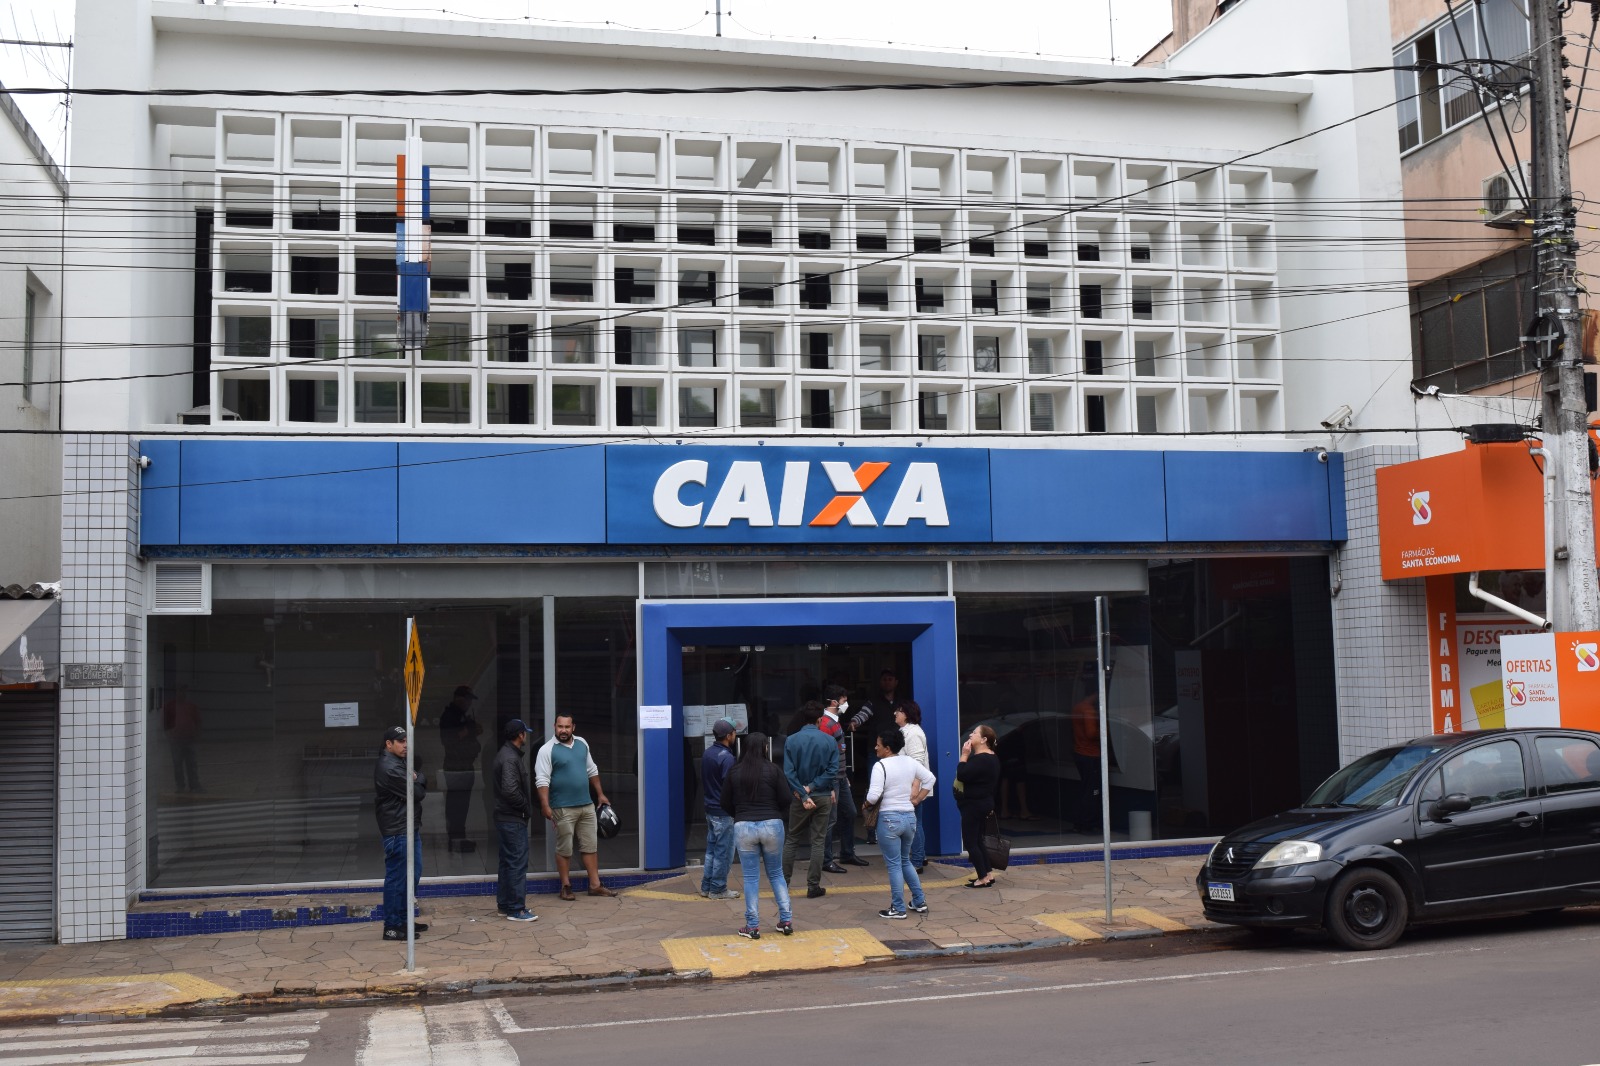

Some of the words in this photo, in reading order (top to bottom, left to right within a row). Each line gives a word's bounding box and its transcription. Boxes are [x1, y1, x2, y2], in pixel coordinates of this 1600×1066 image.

[652, 459, 950, 528] CAIXA
[1401, 547, 1435, 559] FARMÁCIAS
[1402, 558, 1424, 569] SANTA
[1425, 554, 1461, 566] ECONOMIA
[1465, 647, 1489, 656] Pague
[1506, 659, 1552, 673] OFERTAS
